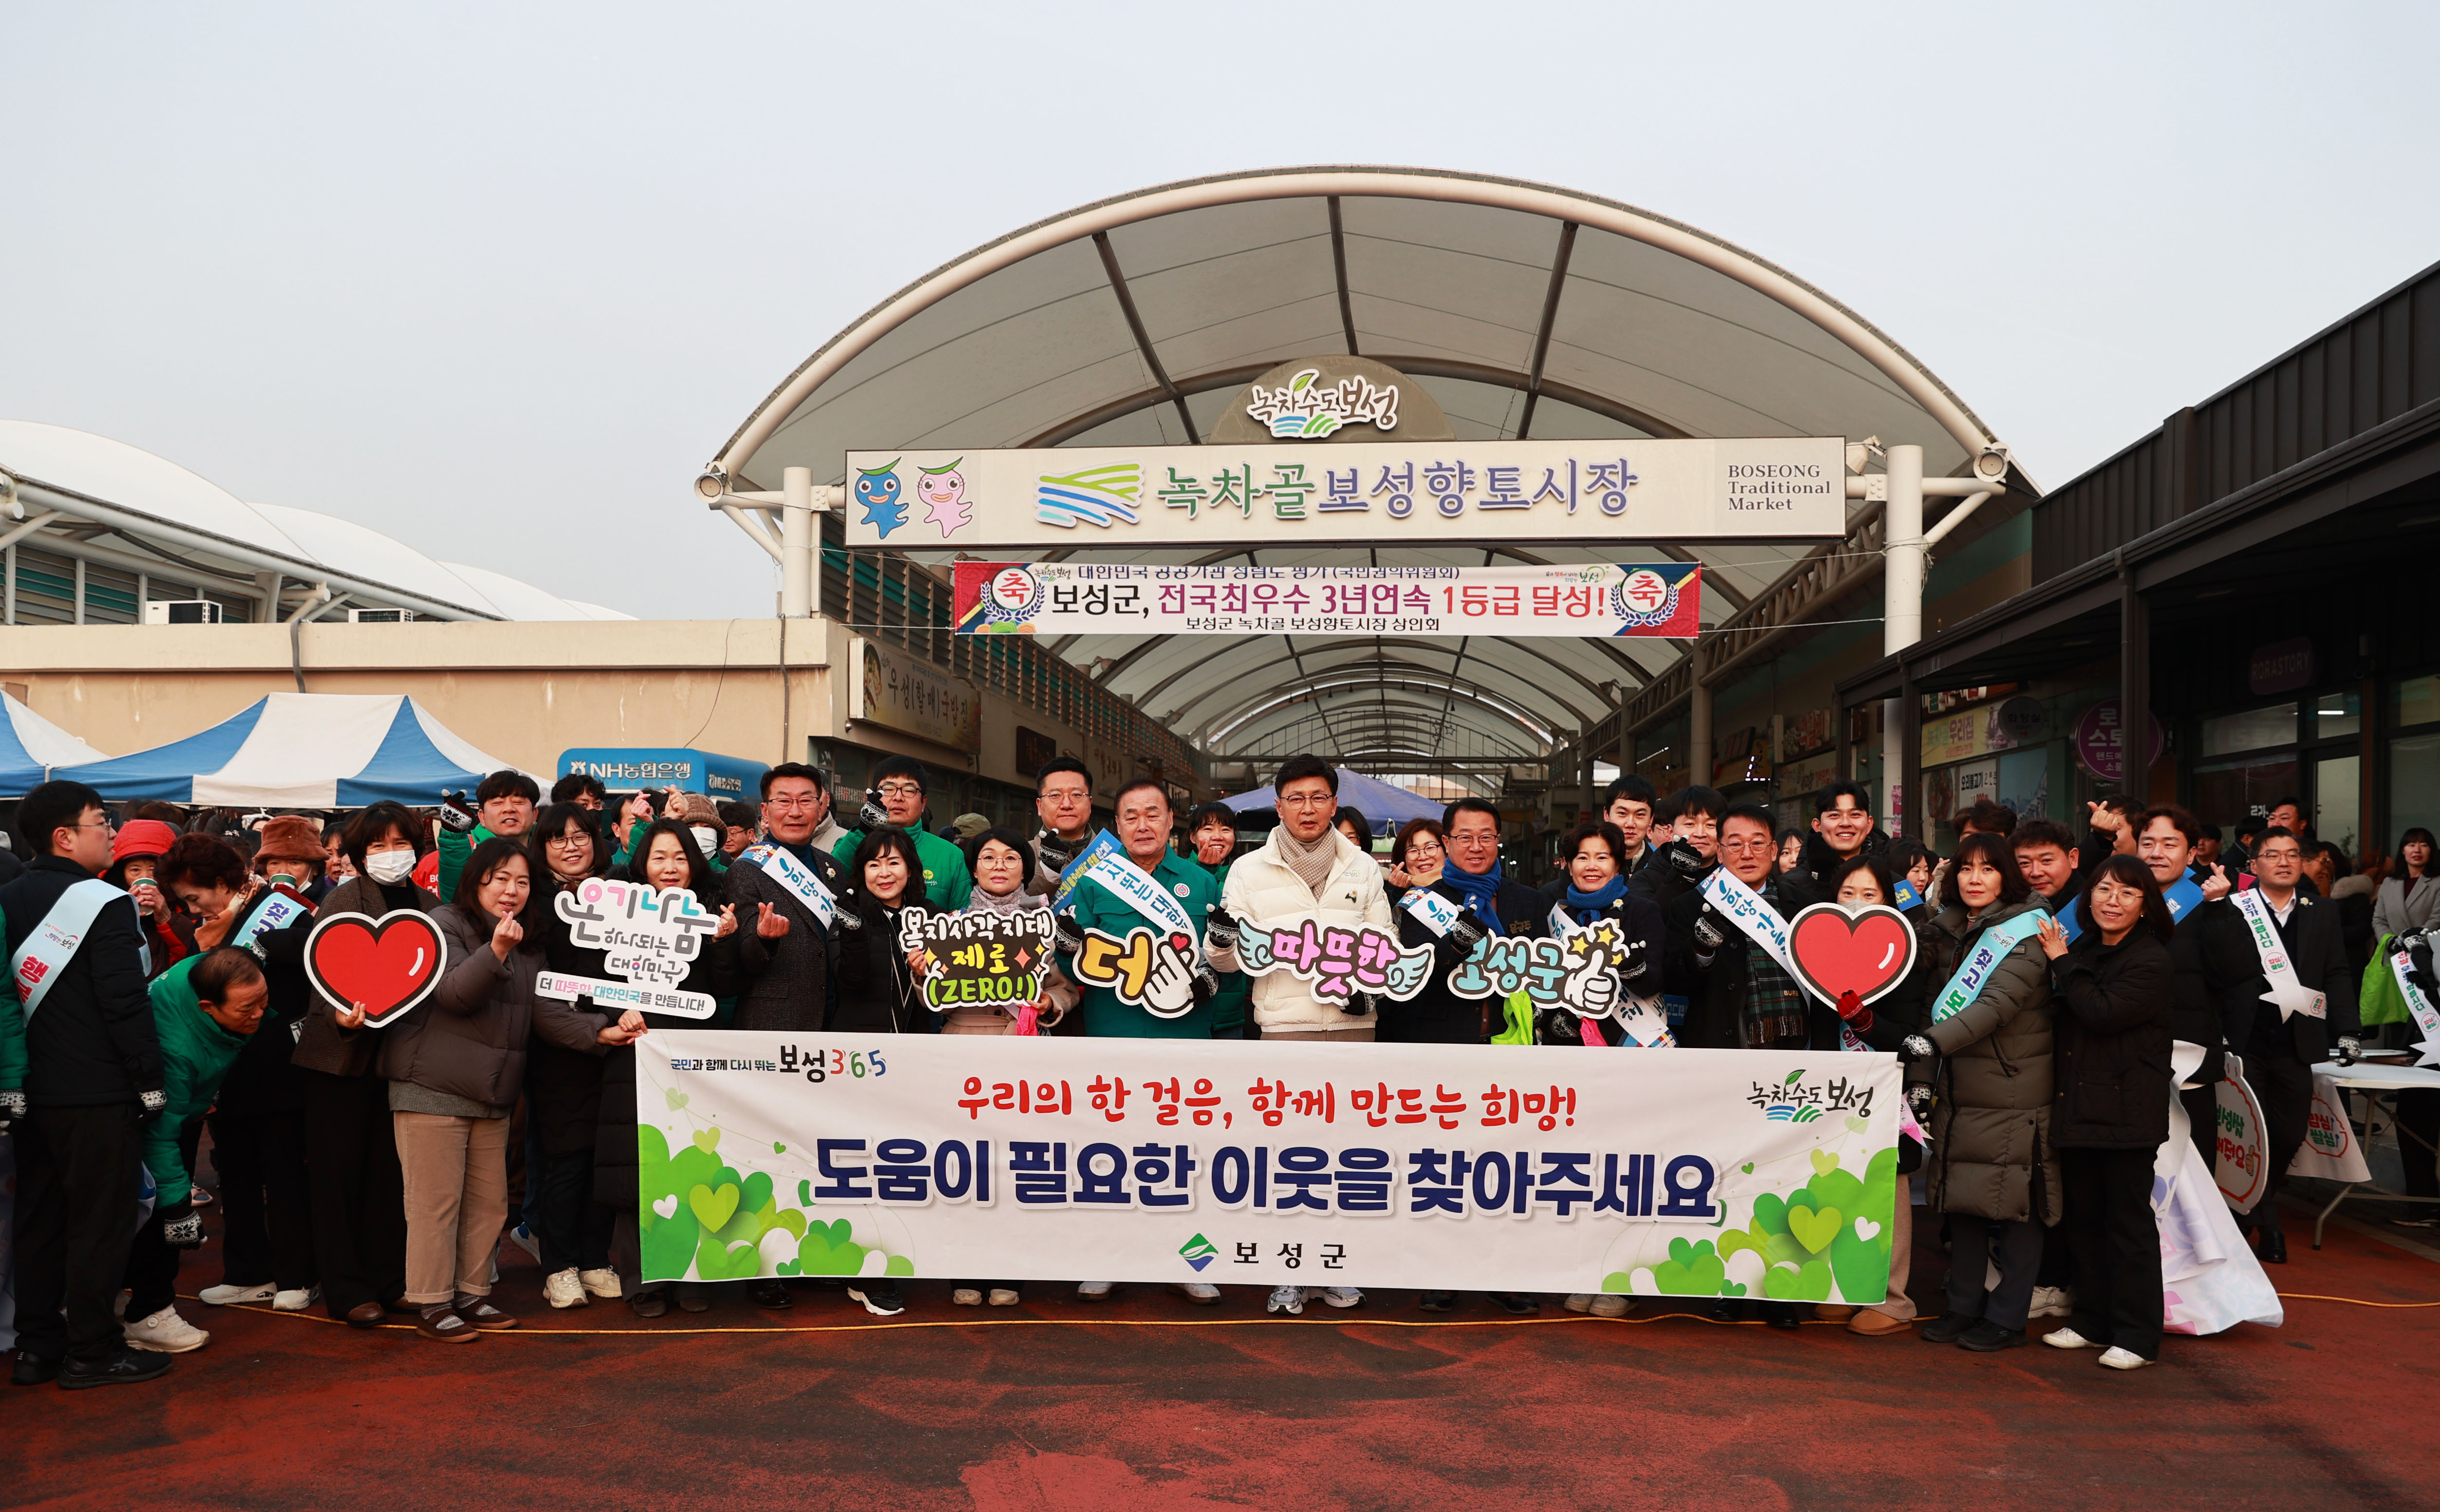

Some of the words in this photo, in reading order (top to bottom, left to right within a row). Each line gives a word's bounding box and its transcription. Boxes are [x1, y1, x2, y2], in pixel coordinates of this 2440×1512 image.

[1250, 388, 1337, 422] 녹차수도
[1340, 379, 1395, 425] 보성
[1728, 464, 1821, 478] BOSEONG
[1728, 480, 1831, 495] Traditional
[1728, 497, 1793, 511] Market
[997, 573, 1032, 605] 축
[1078, 566, 1148, 580] 대한민국
[1292, 567, 1328, 579] 평가
[1579, 572, 1599, 583] 보성
[1052, 584, 1149, 619] 보성군,
[1158, 584, 1310, 614] 전국최우수
[1321, 584, 1431, 615] 3년연속
[1443, 585, 1520, 617] 1등급
[1533, 586, 1604, 618] 달성!
[1627, 574, 1663, 608] 축
[1186, 616, 1233, 631] 보성군
[1238, 617, 1285, 631] 녹차골
[1291, 617, 1387, 632] 보성향토시장
[1391, 617, 1440, 632] 상인회
[2251, 650, 2310, 682] RORASTORY
[1949, 714, 1975, 744] 우리집
[2088, 728, 2122, 747] 스토
[590, 761, 691, 780] NH농협은행
[1095, 858, 1126, 881] 다시
[561, 883, 716, 955] 온기나눔
[905, 912, 1051, 949] 복지사각지대
[2241, 898, 2259, 917] 우리가
[2251, 917, 2274, 948] 먹읍시다
[604, 927, 670, 958] 하나되는
[951, 942, 1010, 974] 제로
[611, 955, 683, 984] 대한민국
[1082, 936, 1148, 997] 더
[1274, 923, 1397, 996] 따뜻한
[1457, 937, 1565, 1000] 보성군
[539, 977, 552, 990] 더
[593, 985, 652, 1005] 대한민국을
[655, 994, 705, 1012] 만듭니다!
[928, 974, 1035, 1006] (ZERO!)
[670, 1058, 703, 1071] 군민과
[705, 1058, 727, 1071] 함께
[730, 1059, 752, 1071] 다시
[755, 1058, 776, 1071] 뛰는
[779, 1044, 826, 1083] 보성
[957, 1076, 1072, 1120] 우리의
[1086, 1074, 1131, 1123] 한
[1143, 1077, 1233, 1129] 걸음,
[1247, 1076, 1335, 1126] 함께
[1350, 1082, 1467, 1131] 만드는
[1480, 1083, 1577, 1133] 희망!
[1746, 1080, 1823, 1111] 녹차수도
[1825, 1075, 1874, 1119] 보성
[814, 1138, 990, 1204] 도움이
[1009, 1141, 1196, 1207] 필요한
[1210, 1146, 1392, 1214] 이웃을
[1407, 1148, 1717, 1219] 찾아주세요
